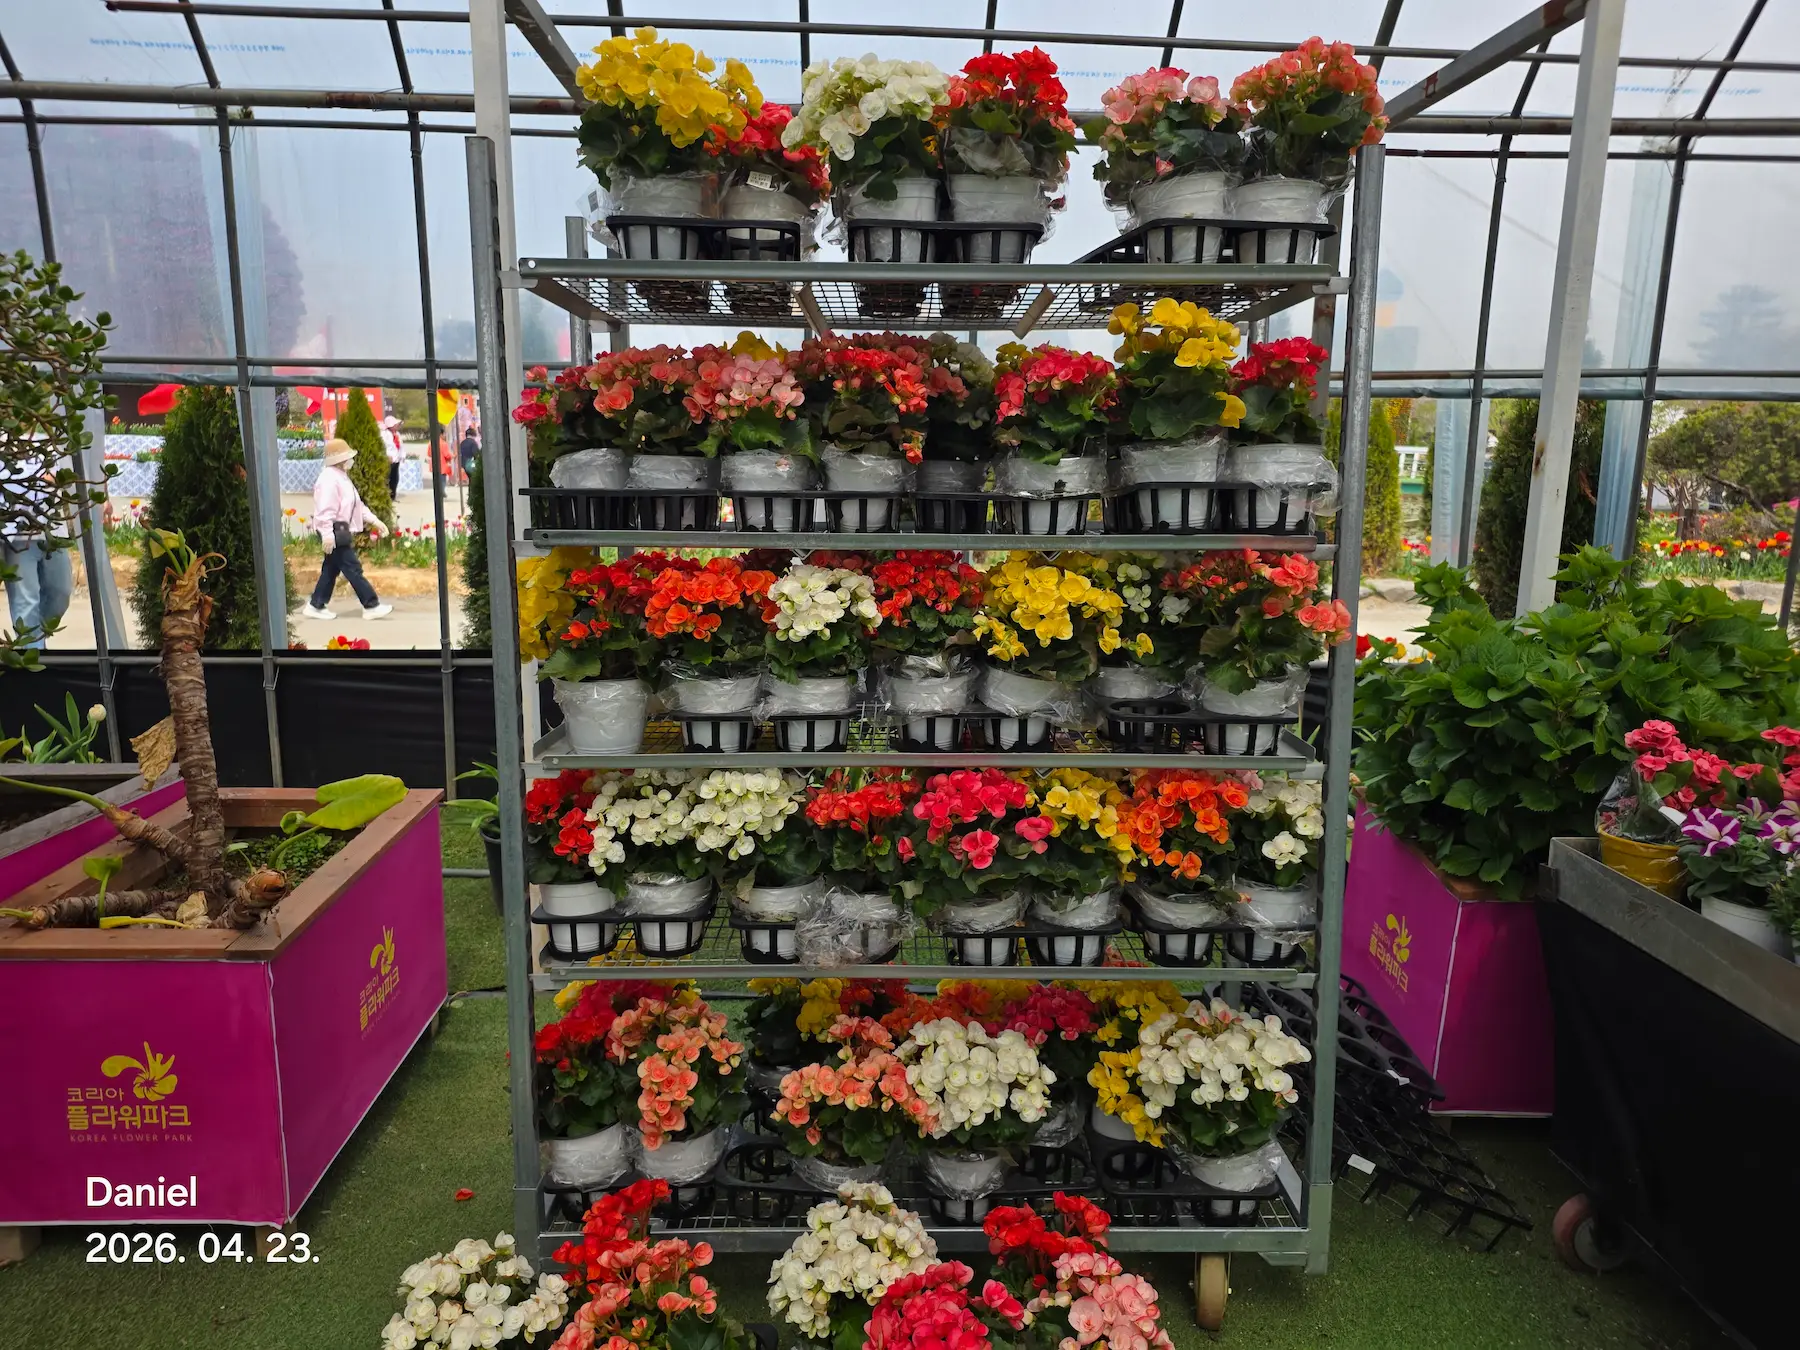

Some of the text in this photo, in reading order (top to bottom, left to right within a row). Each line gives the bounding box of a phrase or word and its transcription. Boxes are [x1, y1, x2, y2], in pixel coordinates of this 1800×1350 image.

[359, 973, 379, 1006] 코리아
[359, 966, 400, 1031] 플라워파크
[67, 1087, 124, 1102] 코리아
[67, 1105, 191, 1130] 플라워파크
[70, 1133, 192, 1142] KOREA FLOWER PARK
